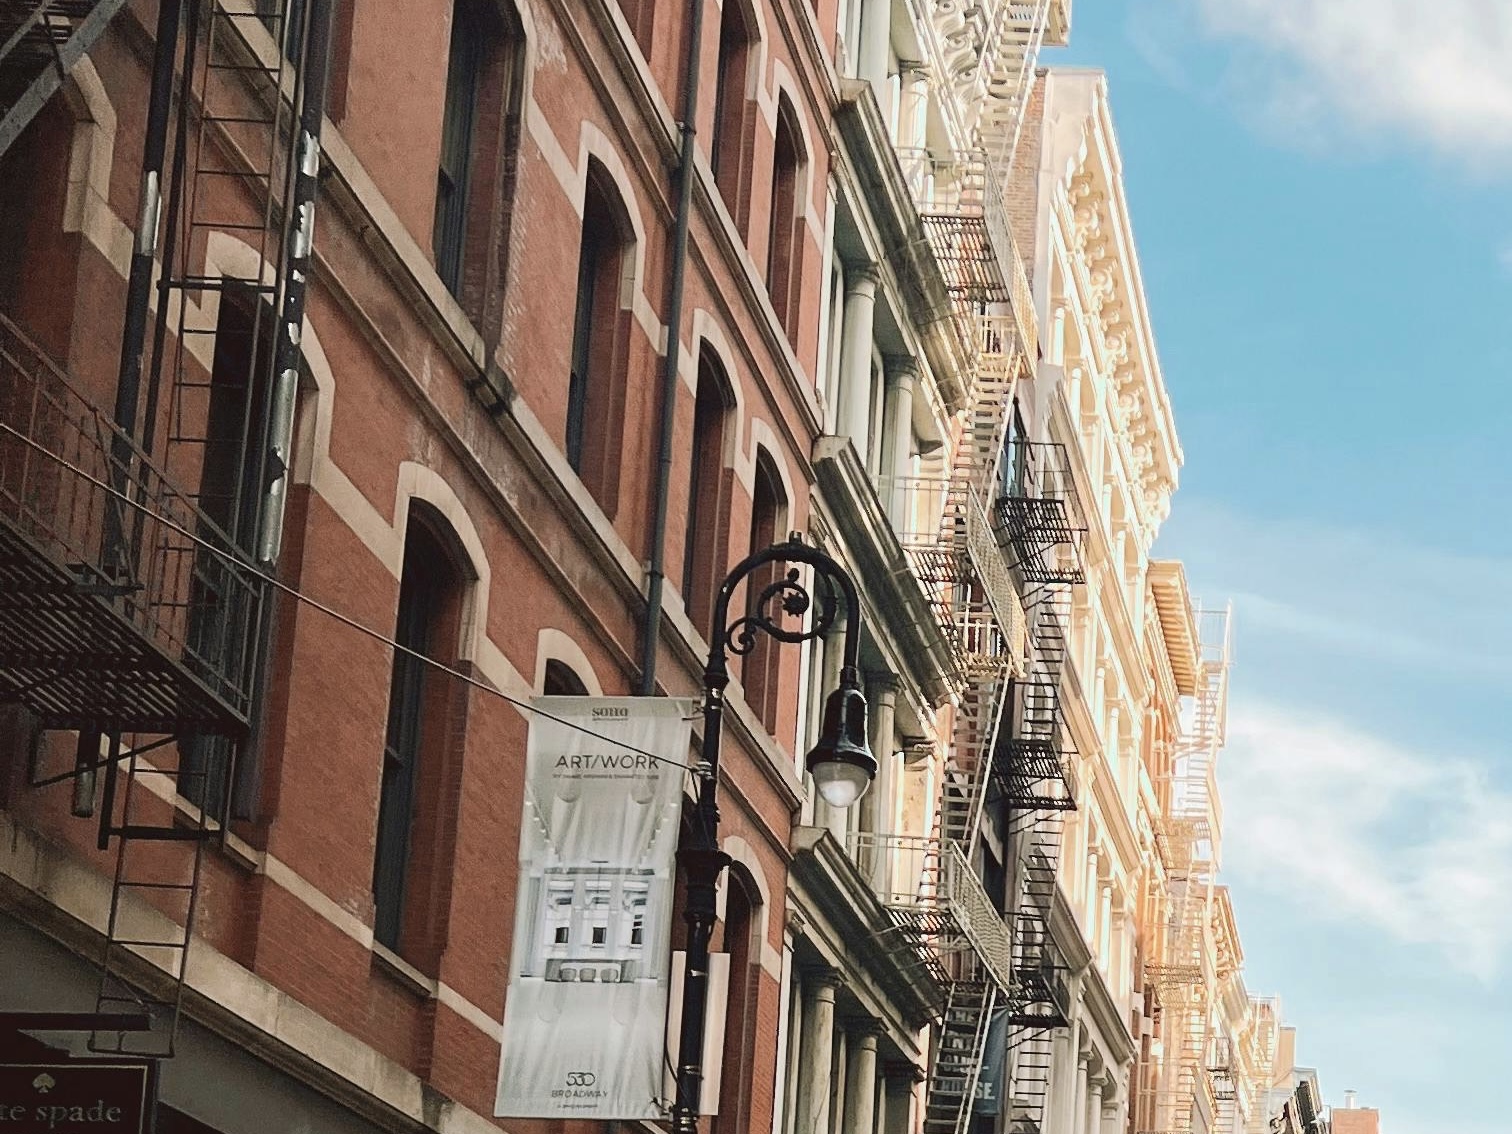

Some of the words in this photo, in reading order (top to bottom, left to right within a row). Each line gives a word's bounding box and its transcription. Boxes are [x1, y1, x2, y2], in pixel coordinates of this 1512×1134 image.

[554, 754, 660, 769] ART/WORK
[566, 1072, 595, 1086] 530
[551, 1089, 609, 1098] BROADWAY
[35, 1099, 122, 1129] spade
